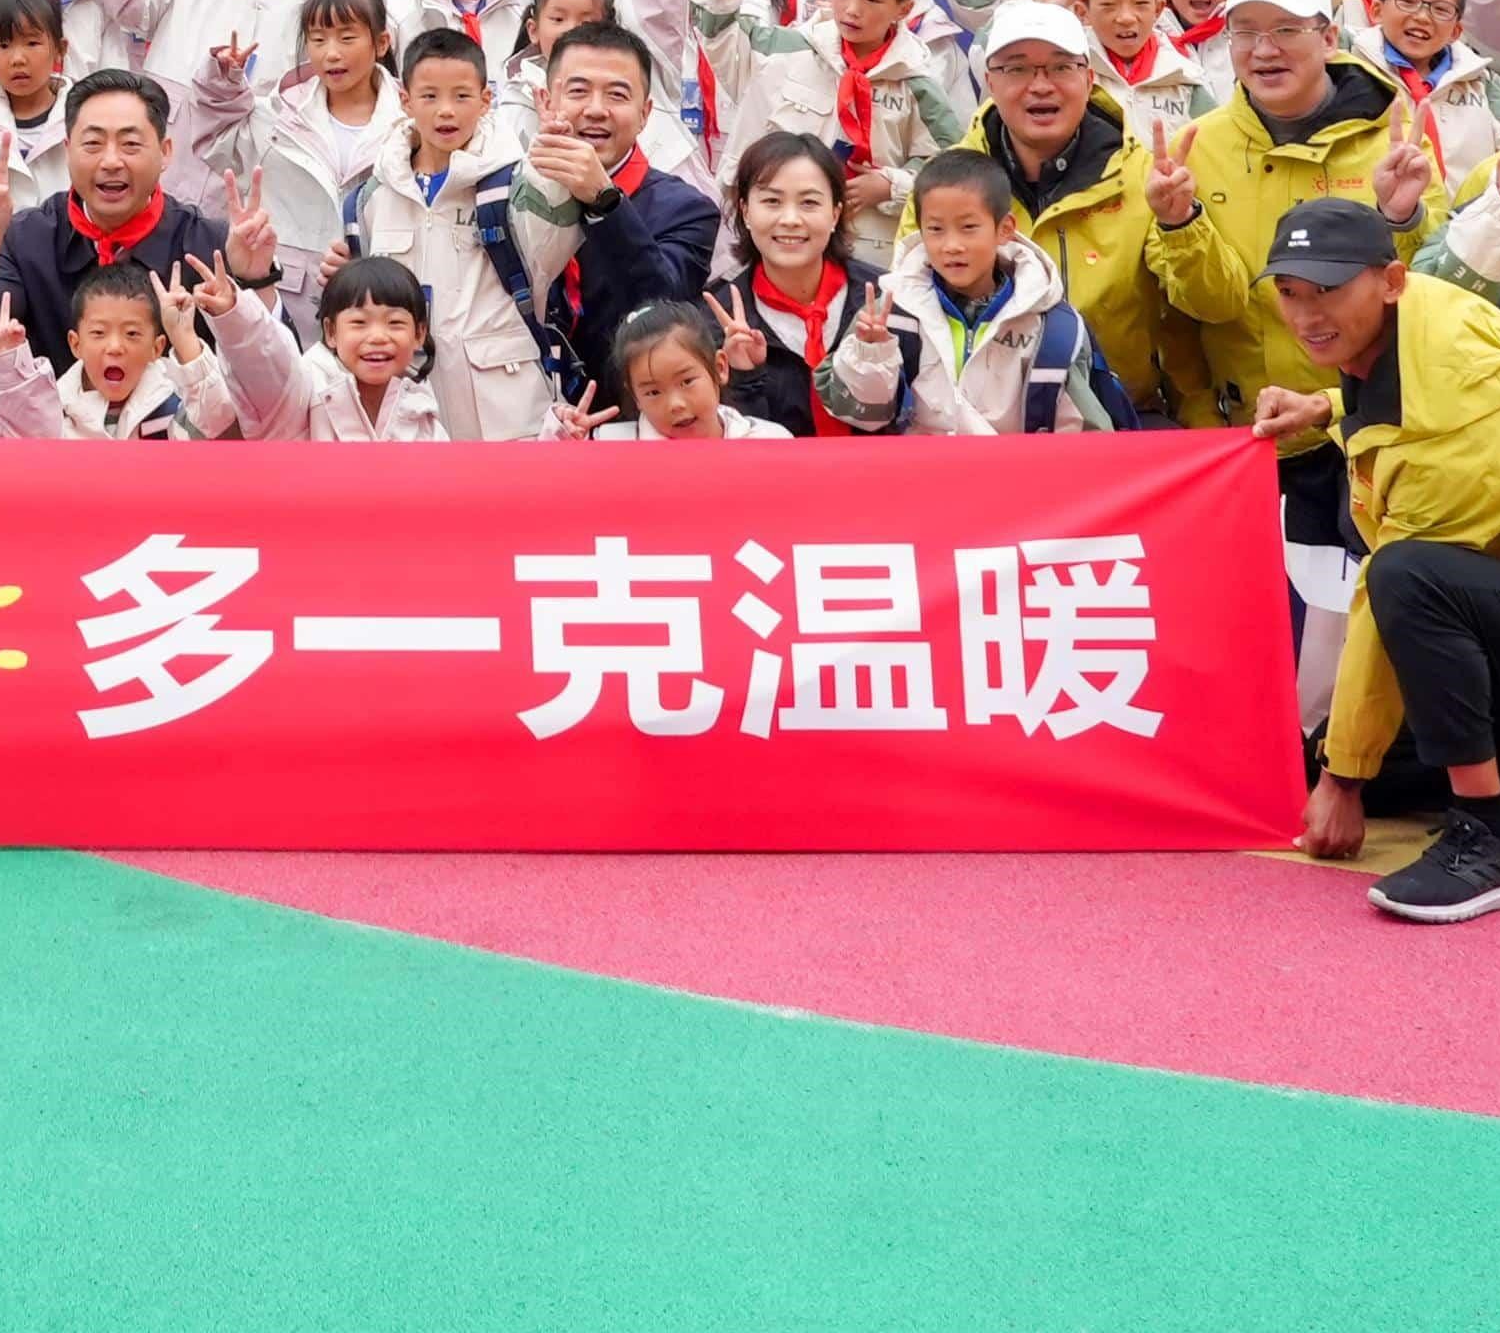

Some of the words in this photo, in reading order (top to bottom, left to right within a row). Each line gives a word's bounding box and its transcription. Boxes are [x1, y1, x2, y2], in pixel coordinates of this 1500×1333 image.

[76, 534, 1163, 741] 多一克温暖
